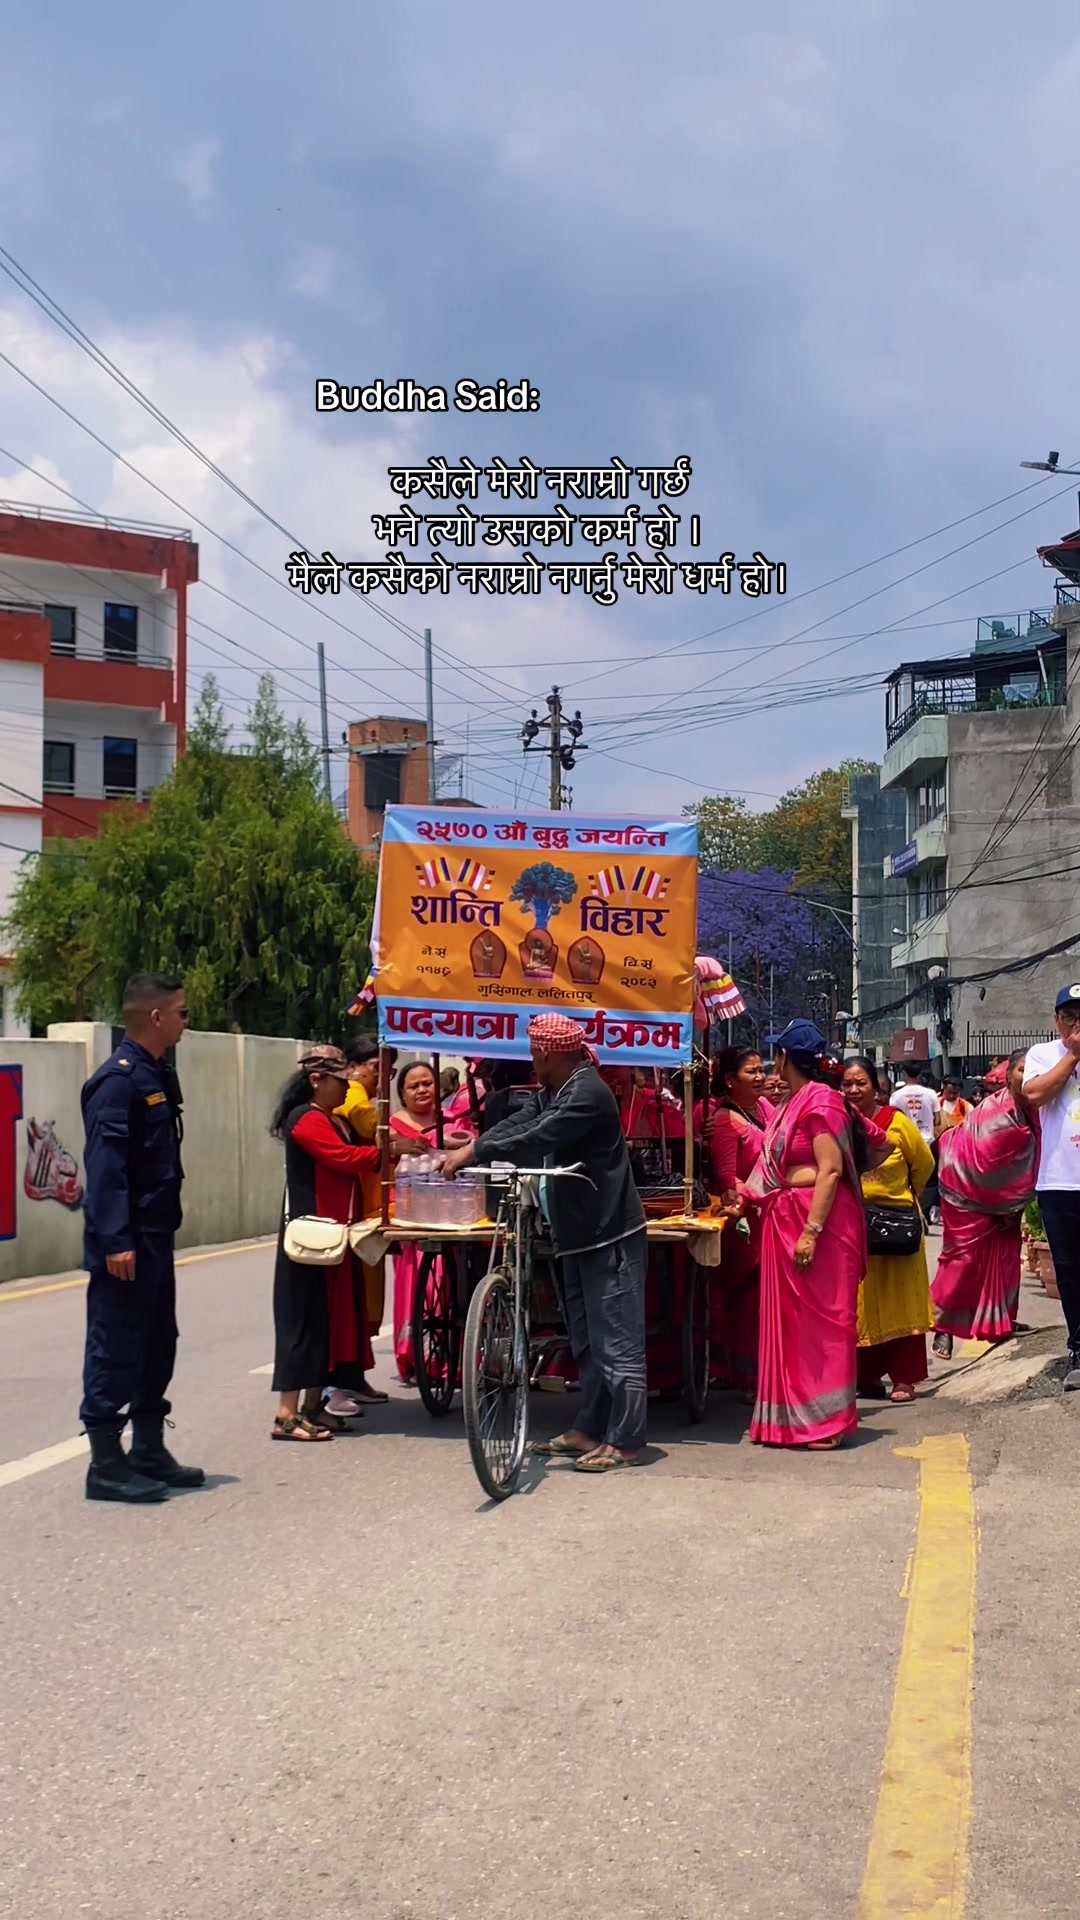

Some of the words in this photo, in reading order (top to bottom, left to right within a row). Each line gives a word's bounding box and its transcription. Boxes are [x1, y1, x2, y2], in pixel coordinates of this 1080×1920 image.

[416, 820, 488, 842] २५७०
[532, 826, 570, 849] बुद्ध
[575, 825, 669, 847] जयन्ति
[410, 889, 504, 927] शान्ति
[580, 896, 670, 937] विहार
[416, 965, 452, 978] ११४६
[620, 976, 657, 989] २०८३
[537, 986, 597, 1004] ललितपुर
[385, 1006, 519, 1041] पदयात्रा
